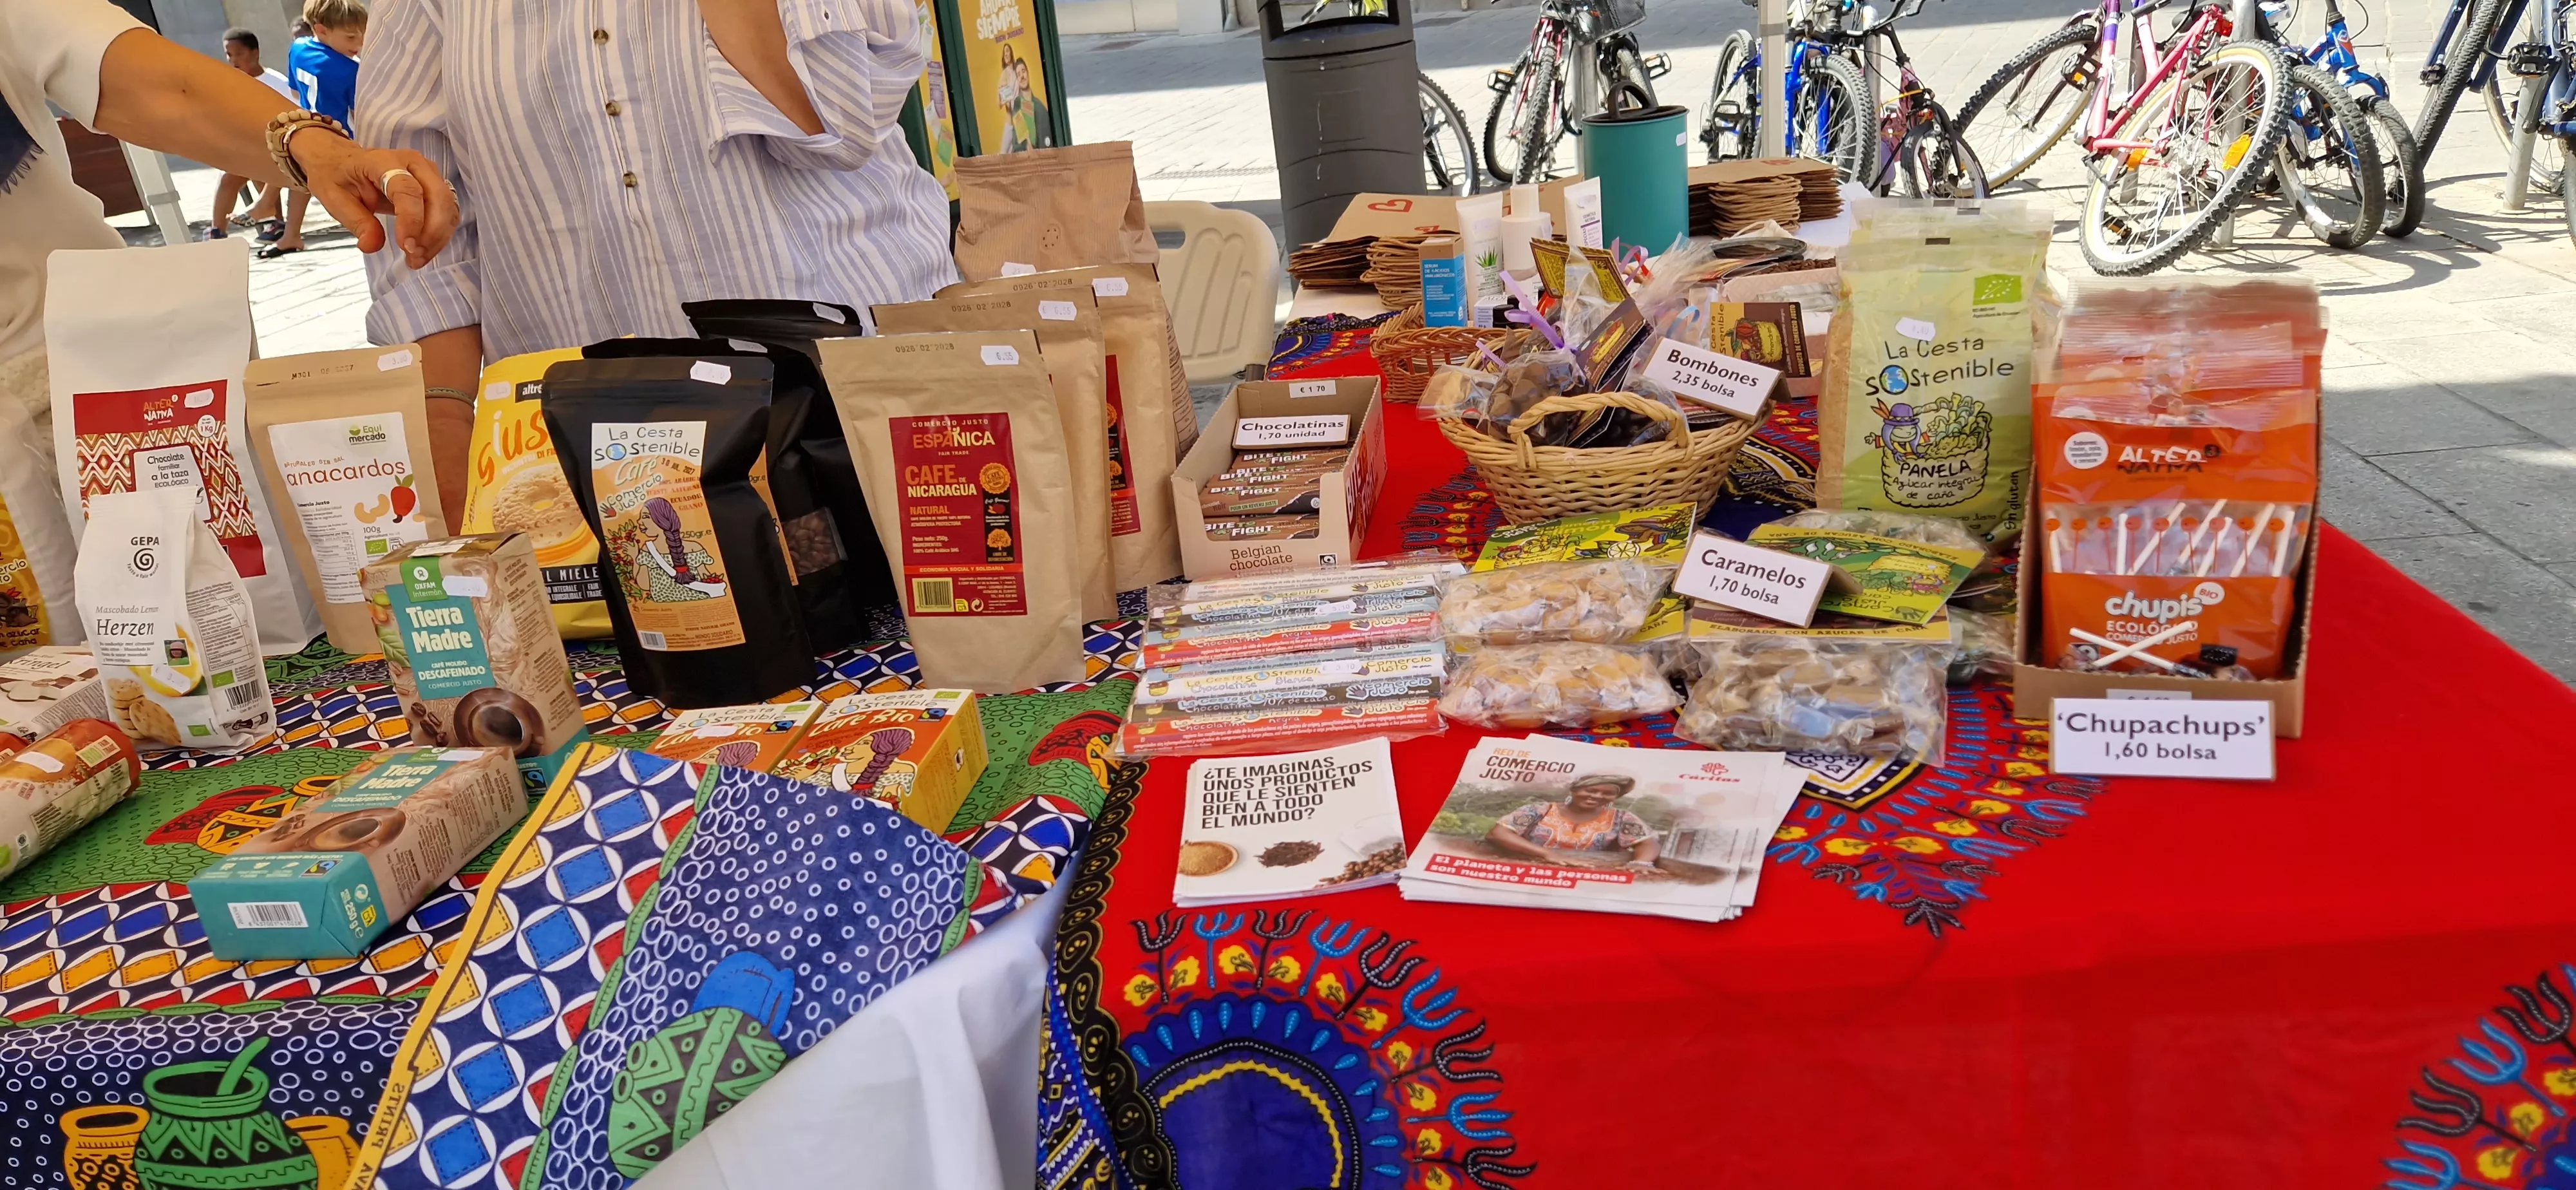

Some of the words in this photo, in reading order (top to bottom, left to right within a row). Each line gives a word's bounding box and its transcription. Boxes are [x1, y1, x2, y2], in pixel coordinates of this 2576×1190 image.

[977, 6, 1021, 40] SIEMPRE
[296, 67, 319, 112] 7
[1884, 341, 1909, 360] La
[1917, 337, 1984, 358] Cesta
[996, 352, 1014, 361] 6.55
[1667, 348, 1759, 388] Bombones
[1672, 370, 1700, 389] 2,35
[1701, 378, 1736, 399] bolsa
[144, 399, 174, 411] ALTER
[144, 408, 173, 421] NATIVA
[363, 424, 382, 434] Equi
[609, 428, 628, 440] La
[637, 427, 683, 439] Cesta
[1242, 421, 1344, 431] Chocolatinas
[349, 432, 386, 443] mercado
[147, 453, 185, 464] Chocolate
[1243, 452, 1273, 460] BITE
[1271, 454, 1309, 464] FIGHT
[287, 458, 406, 486] anacardos
[615, 455, 660, 486] Café
[905, 464, 958, 485] CAFE
[1900, 459, 1972, 478] PANELA
[1249, 475, 1289, 483] FIGHT
[607, 473, 662, 506] Comercio
[907, 484, 978, 498] NICARAGUA
[1240, 487, 1282, 496] FIGHT
[1906, 491, 1918, 500] de
[1927, 491, 1956, 500] caña
[619, 493, 646, 511] Justo
[670, 493, 702, 503] ECUADOR
[678, 502, 703, 511] GRANO
[910, 505, 950, 515] NATURAL
[1206, 522, 1237, 531] BITE
[1231, 525, 1274, 536] FIGHT
[131, 536, 160, 546] GEPA
[1231, 545, 1282, 560] Belgian
[1899, 542, 1959, 560] ELABORADO
[1229, 553, 1293, 571] chocolate
[1701, 549, 1807, 590] Caramelos
[560, 567, 599, 581] MIELE
[1709, 575, 1739, 593] 1,70
[1741, 583, 1780, 606] bolsa
[96, 605, 139, 614] Mascobado
[1823, 600, 1894, 613] Comerc
[2105, 589, 2204, 624] chupis
[2199, 588, 2219, 600] BIO
[405, 606, 464, 628] Tierra
[1374, 618, 1407, 626] Justo
[7, 627, 40, 637] azucar
[97, 618, 155, 636] Herzen
[1640, 620, 1668, 633] CAÑA
[1709, 623, 1777, 635] ELABORADO
[2106, 619, 2199, 635] ECOLÓGO
[411, 628, 473, 653] Madre
[1196, 637, 1260, 648] Chocolatina
[1281, 631, 1311, 639] negra
[2166, 632, 2198, 644] JUSTO
[1367, 656, 1432, 667] Comercio
[418, 666, 486, 681] DESCAFEINADO
[1191, 682, 1258, 694] Chocolatina
[1375, 663, 1408, 673] Justo
[428, 681, 460, 689] COMERCIO
[1365, 679, 1431, 689] Comercio
[1186, 703, 1252, 712] Chocolatina
[1370, 686, 1406, 695] Justo
[809, 712, 872, 737] Café
[869, 709, 914, 724] Bio
[1179, 722, 1246, 732] Chocolatina
[1269, 716, 1300, 724] negra
[1367, 704, 1403, 713] Justo
[1493, 748, 1515, 756] RED
[2104, 743, 2148, 760] 1,60
[2156, 744, 2218, 760] bolsa
[381, 764, 438, 777] Tierra
[1204, 768, 1236, 779] ¿TE
[1243, 757, 1335, 777] IMAGINAS
[1486, 756, 1576, 773] COMERCIO
[359, 776, 422, 789] Madre
[1204, 779, 1255, 791] UNOS
[1262, 760, 1373, 788] PRODUCTOS
[1479, 768, 1535, 783] JUSTO
[1203, 791, 1240, 805] QUE
[1247, 788, 1269, 801] LE
[1275, 777, 1356, 798] SIENTEN
[1202, 803, 1247, 817] BIEN
[1254, 800, 1266, 812] A
[1273, 794, 1324, 811] TODO
[1202, 817, 1224, 829] EL
[1231, 808, 1316, 827] MUNDO?
[1430, 864, 1456, 874] son
[1461, 868, 1519, 882] nuestro
[1524, 876, 1572, 887] mundo
[1435, 855, 1449, 864] El
[1454, 858, 1511, 873] planeta
[1530, 866, 1552, 876] las
[1558, 870, 1627, 882] personas
[346, 903, 357, 920] 250
